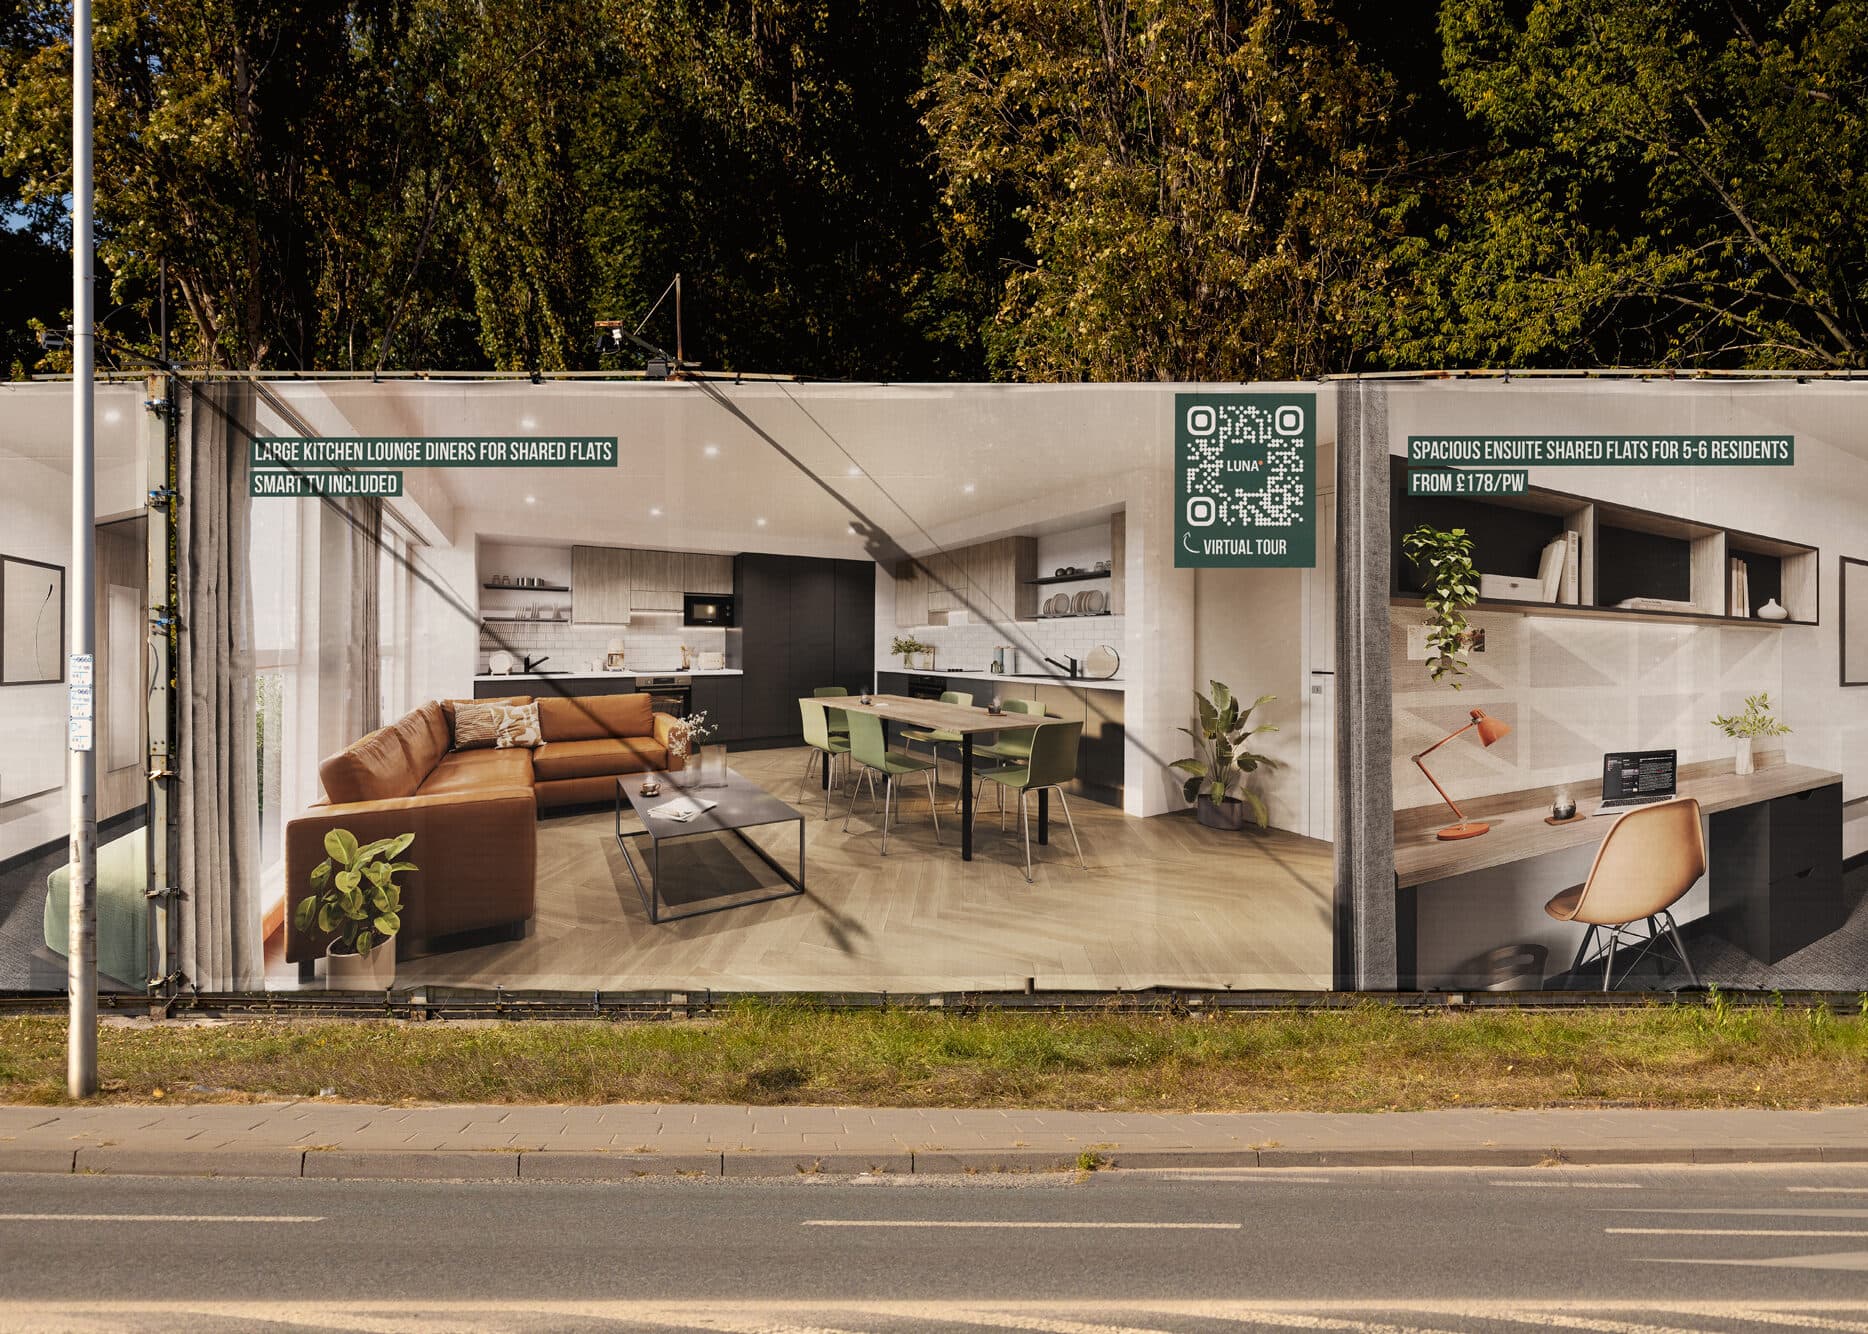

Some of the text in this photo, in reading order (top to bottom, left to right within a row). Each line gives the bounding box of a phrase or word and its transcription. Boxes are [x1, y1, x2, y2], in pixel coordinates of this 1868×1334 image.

[254, 441, 612, 461] LARGE KITCHEN LOUNGE DINERS FOR SHARED FLATS
[1412, 440, 1789, 460] SPACIOUS ENSUITE SHARED FLATS FOR 5-6 RESIDENTS
[1226, 459, 1260, 472] LUNA
[254, 474, 398, 494] SMART TV INCLUDED
[1412, 473, 1525, 493] FROM £178/PW
[1203, 538, 1287, 556] VIRTUAL TOUR
